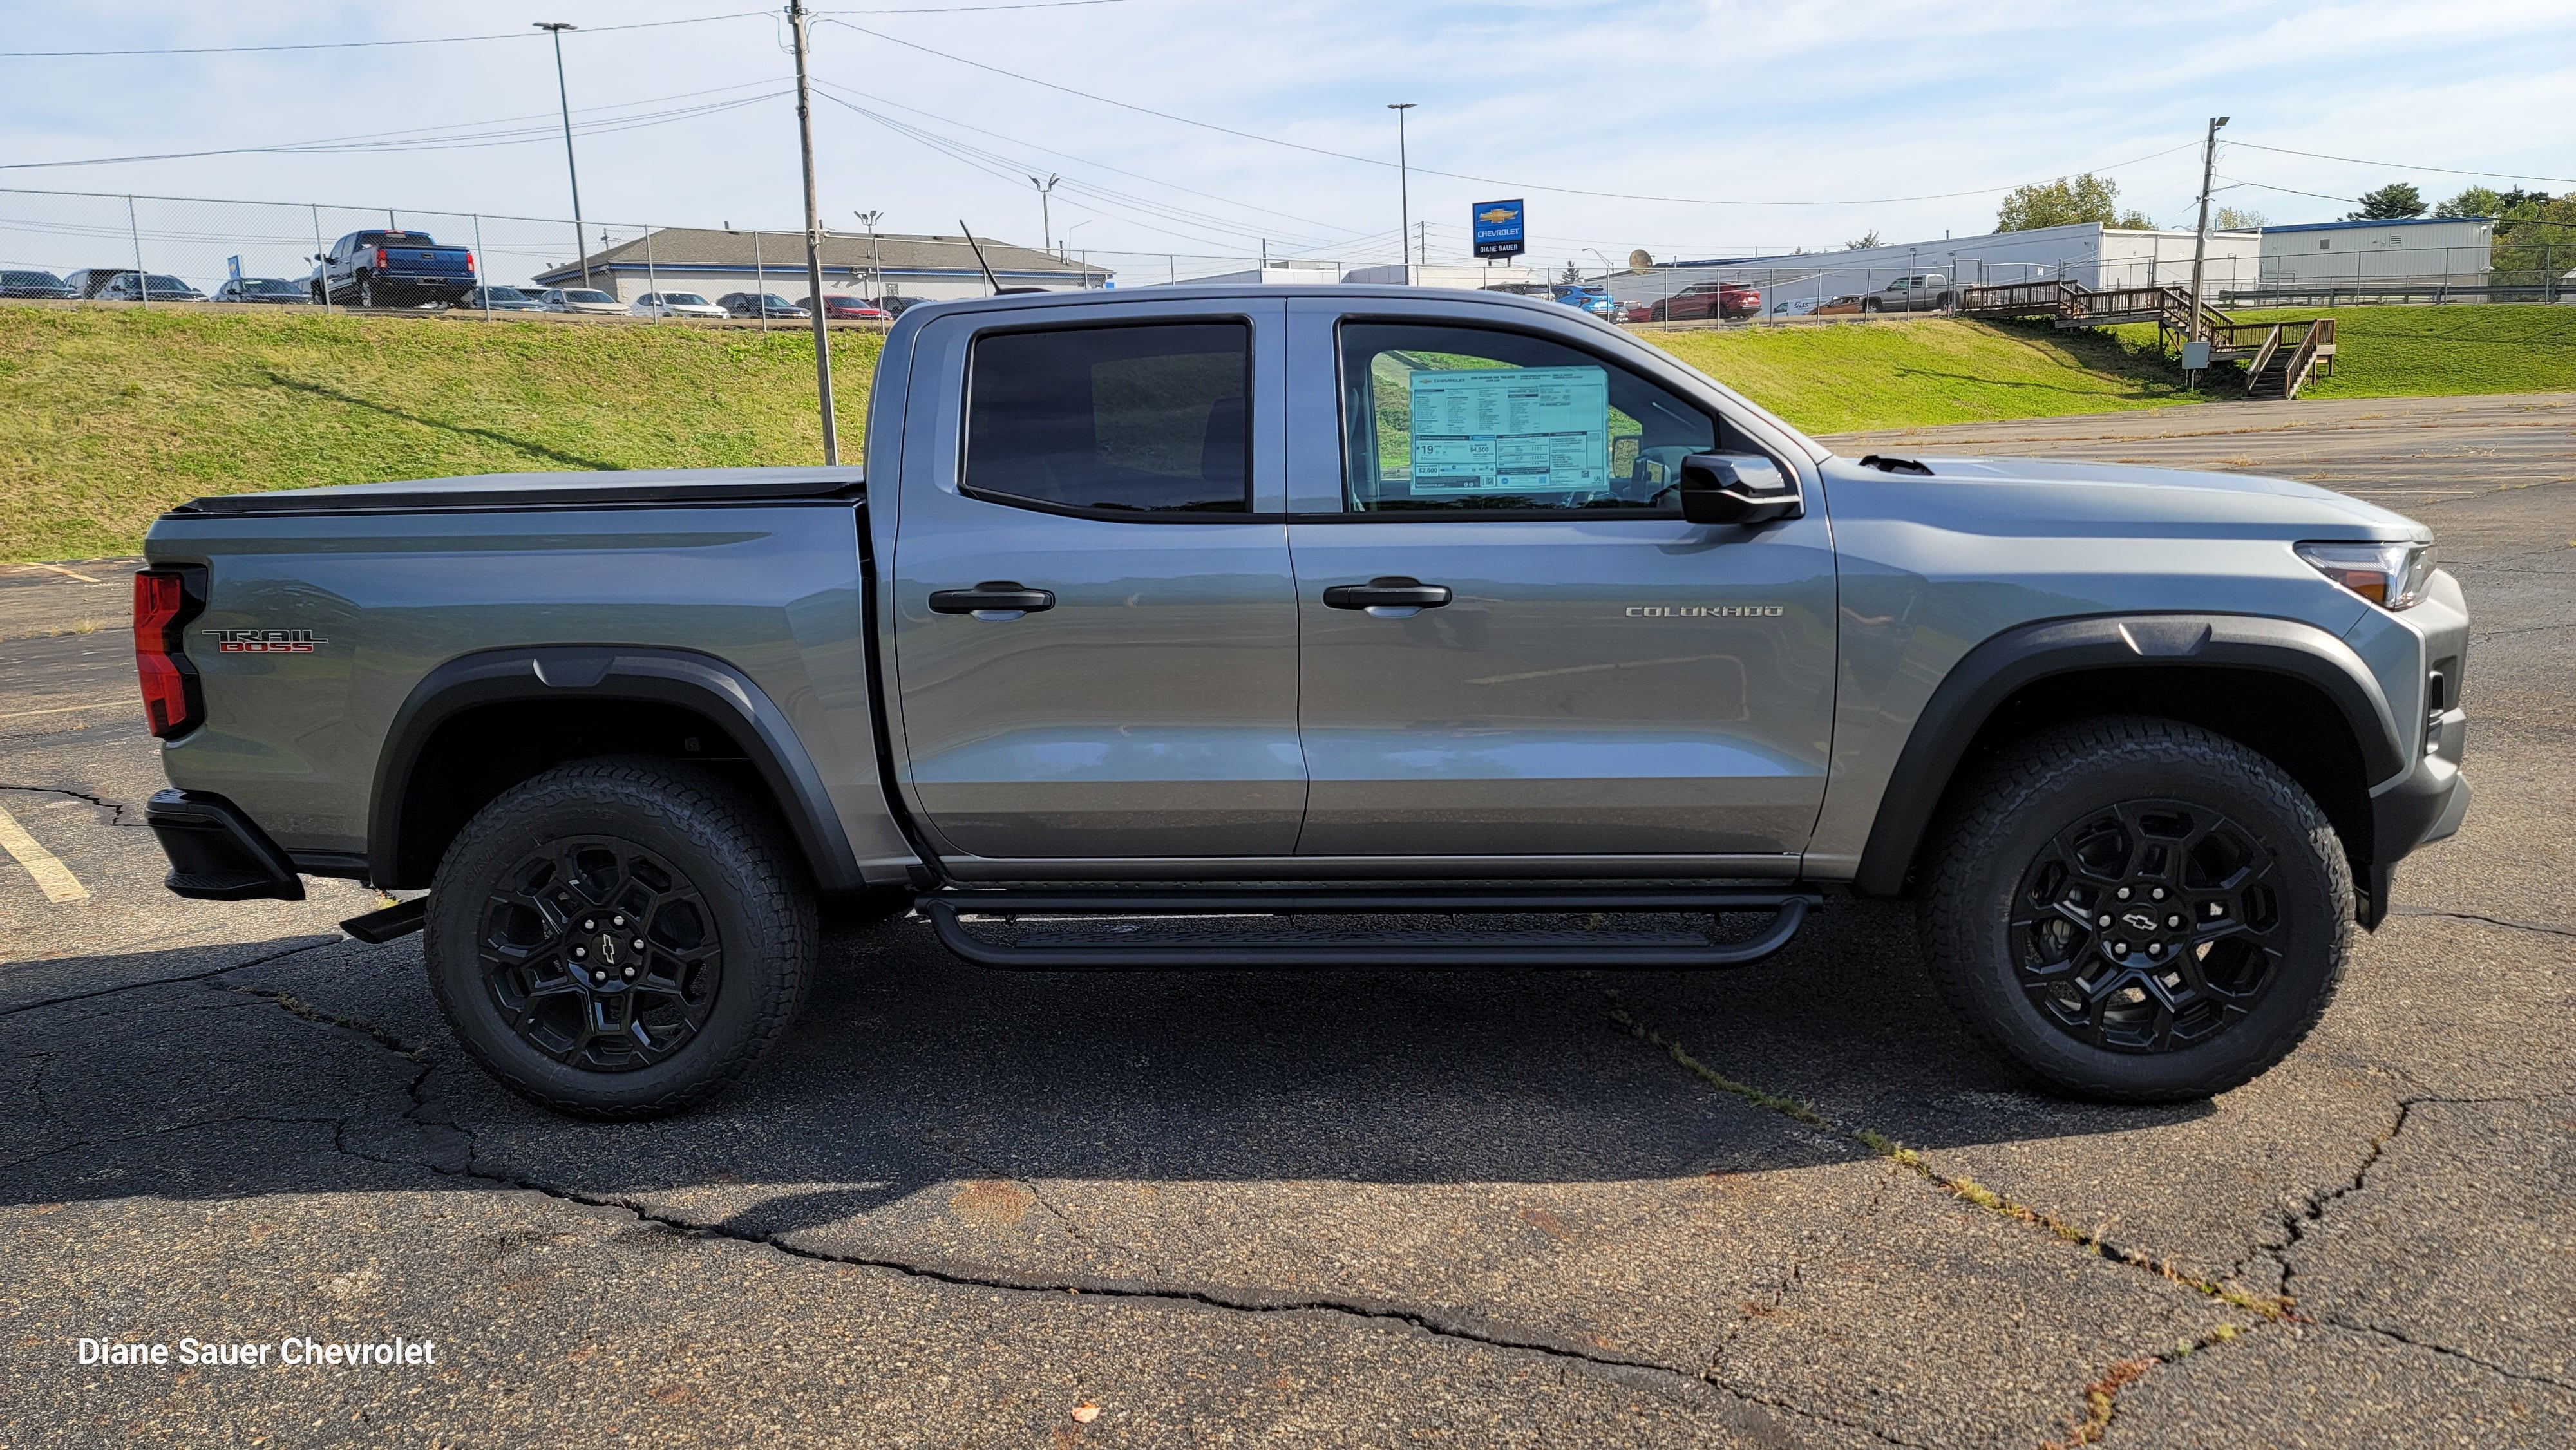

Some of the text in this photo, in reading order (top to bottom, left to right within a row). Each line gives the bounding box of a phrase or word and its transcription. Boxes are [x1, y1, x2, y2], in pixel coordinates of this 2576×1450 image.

[1477, 228, 1519, 238] CHEVROLET
[1421, 445, 1434, 455] 19
[1625, 605, 1784, 618] COLORADO
[201, 629, 328, 643] TRAIL
[219, 641, 314, 653] BOSS
